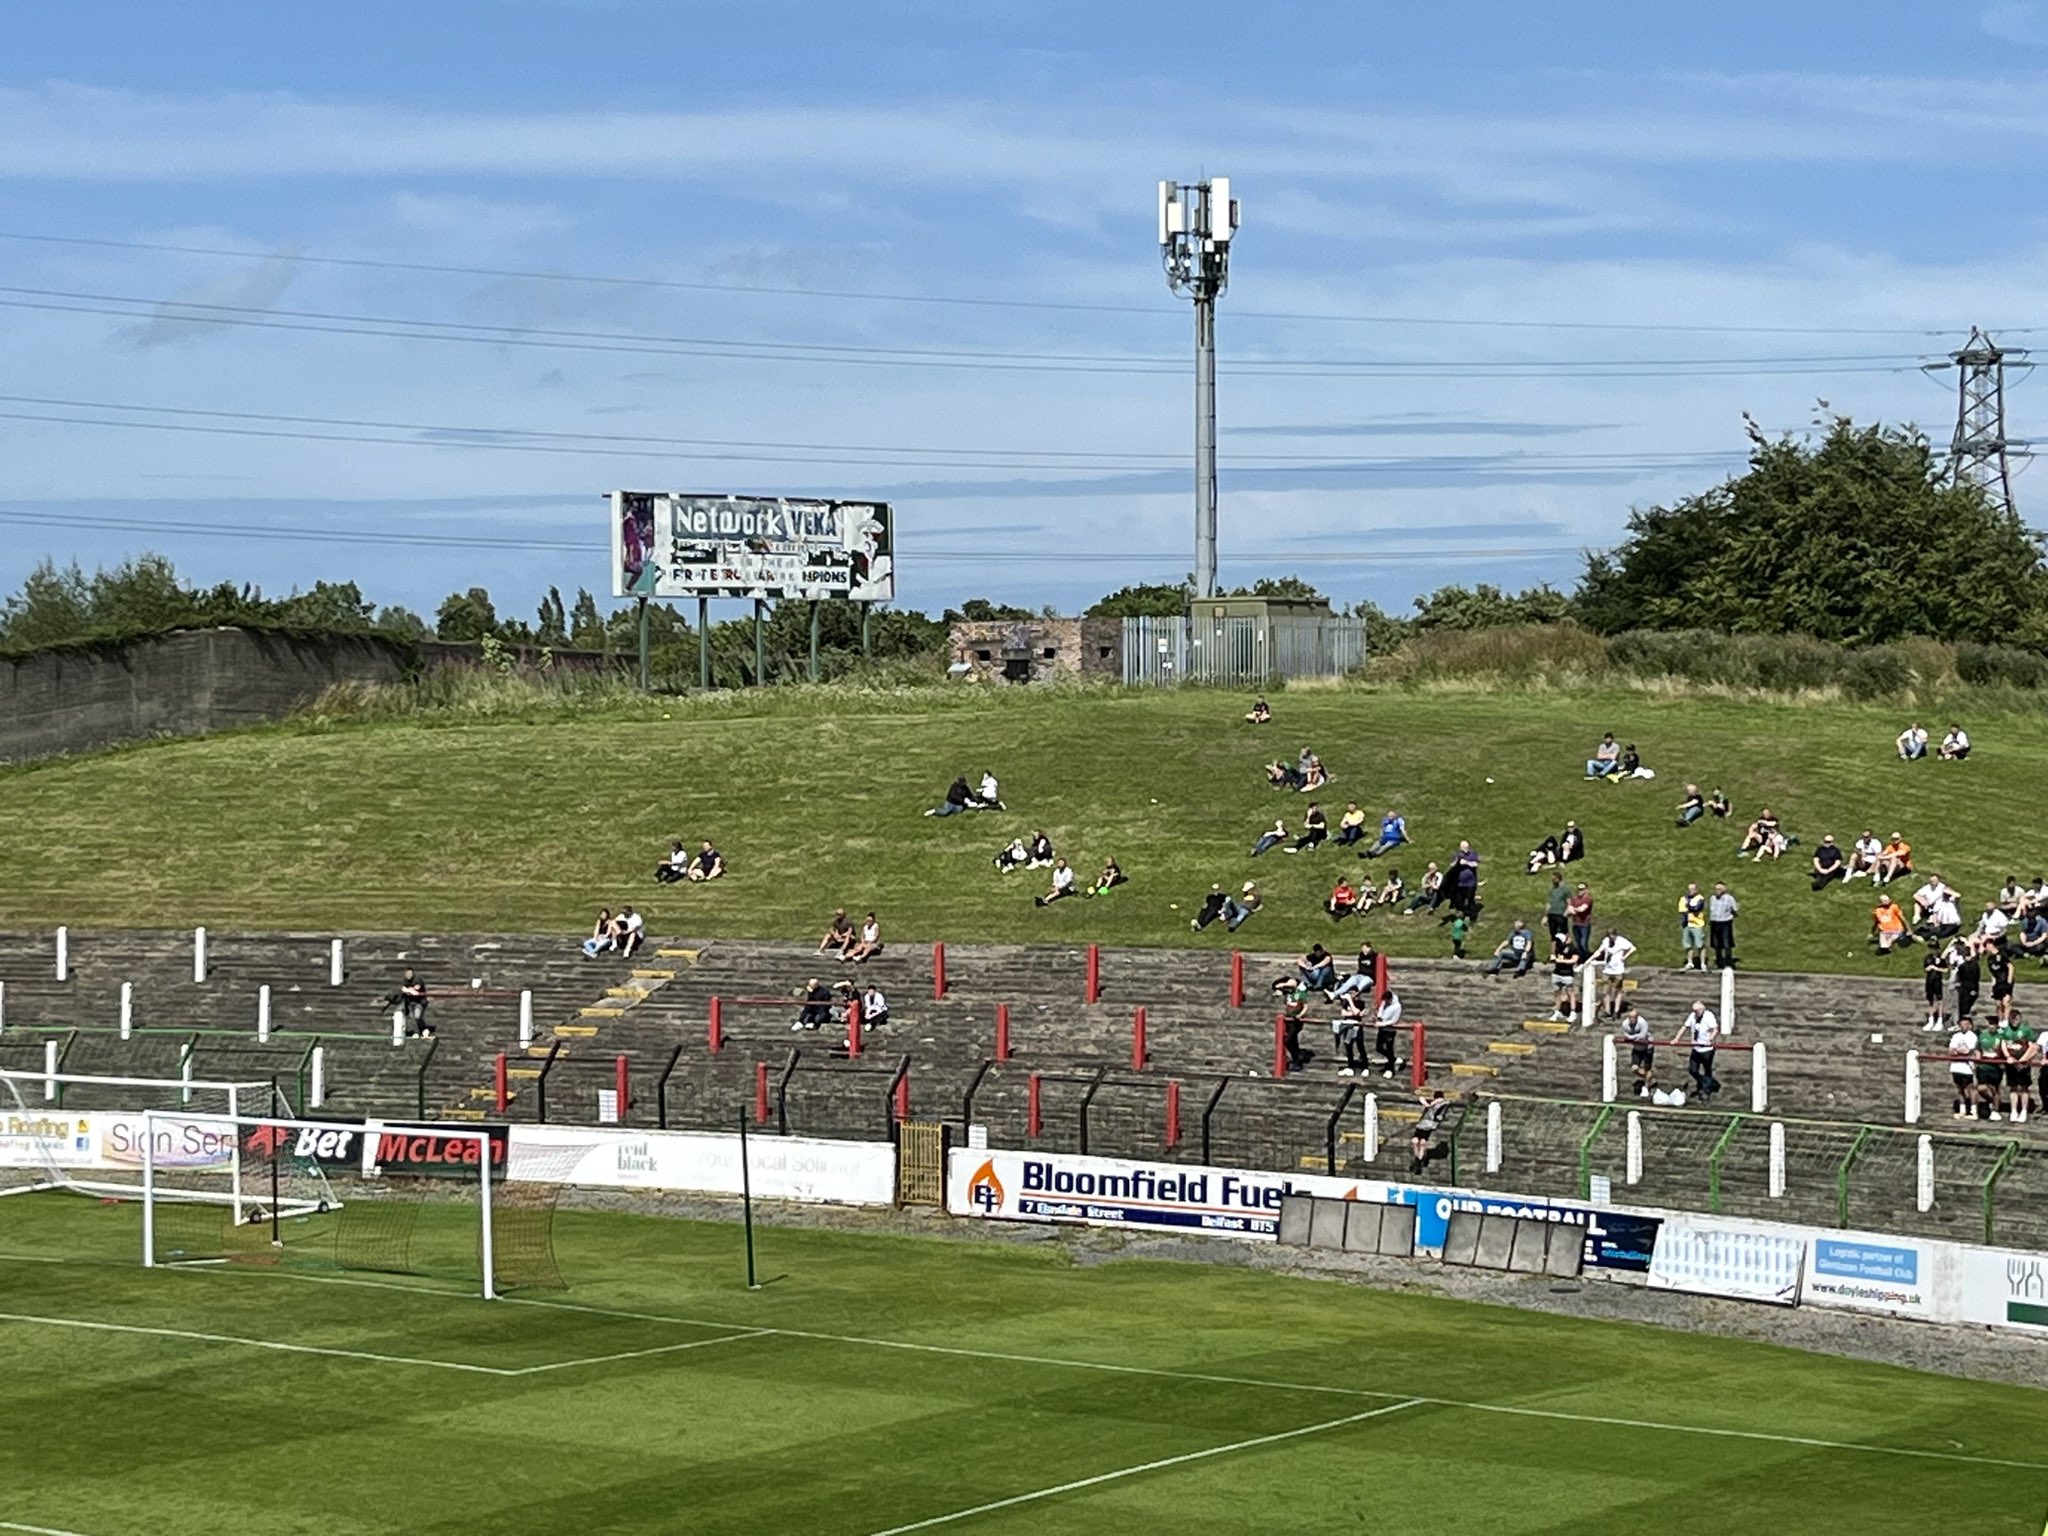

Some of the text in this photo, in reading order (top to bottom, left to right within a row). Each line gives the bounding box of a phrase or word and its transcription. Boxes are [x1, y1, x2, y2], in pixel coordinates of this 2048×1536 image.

[675, 505, 783, 536] Network
[294, 1128, 353, 1158] Bet
[376, 1133, 503, 1164] McLean
[617, 1156, 657, 1172] black
[1022, 1161, 1207, 1204] Bloomfield
[1026, 1201, 1034, 1213] 7
[1087, 1206, 1124, 1220] Street
[1201, 1215, 1244, 1229] Belfast
